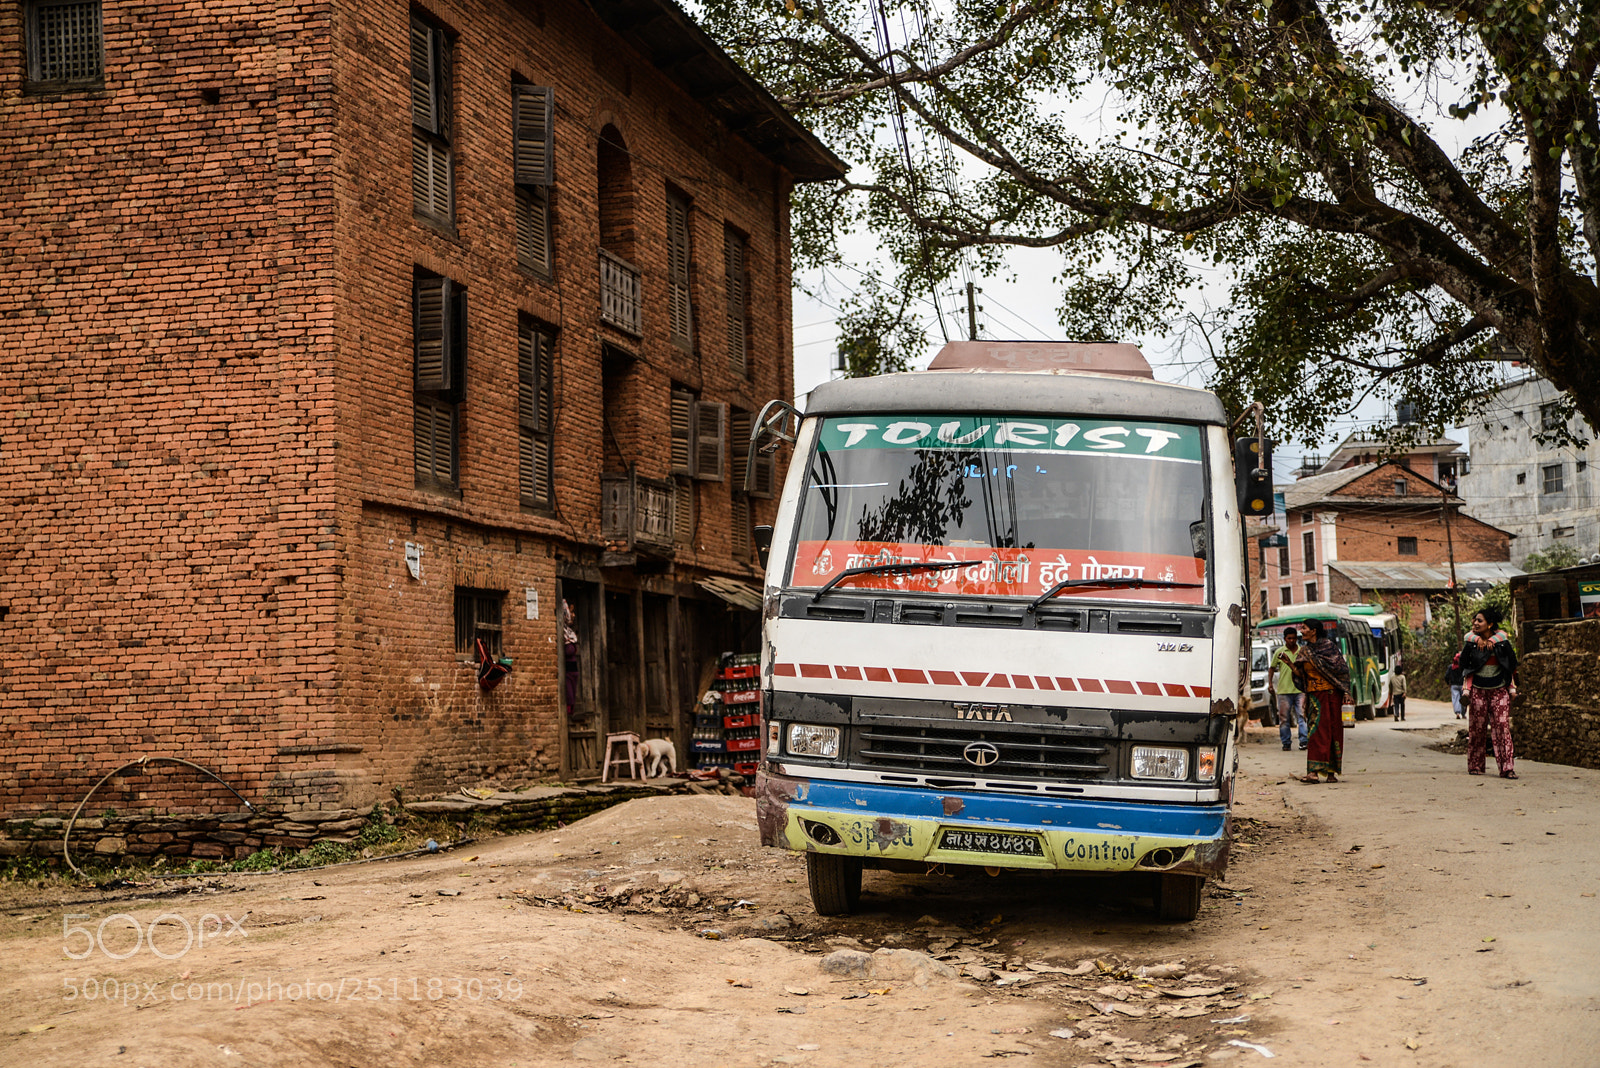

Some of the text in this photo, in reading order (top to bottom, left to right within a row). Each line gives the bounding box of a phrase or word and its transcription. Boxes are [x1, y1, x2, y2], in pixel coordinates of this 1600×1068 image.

[836, 421, 1181, 454] TOURIST
[953, 703, 1013, 721] TATA
[852, 821, 1136, 860] Spd Control
